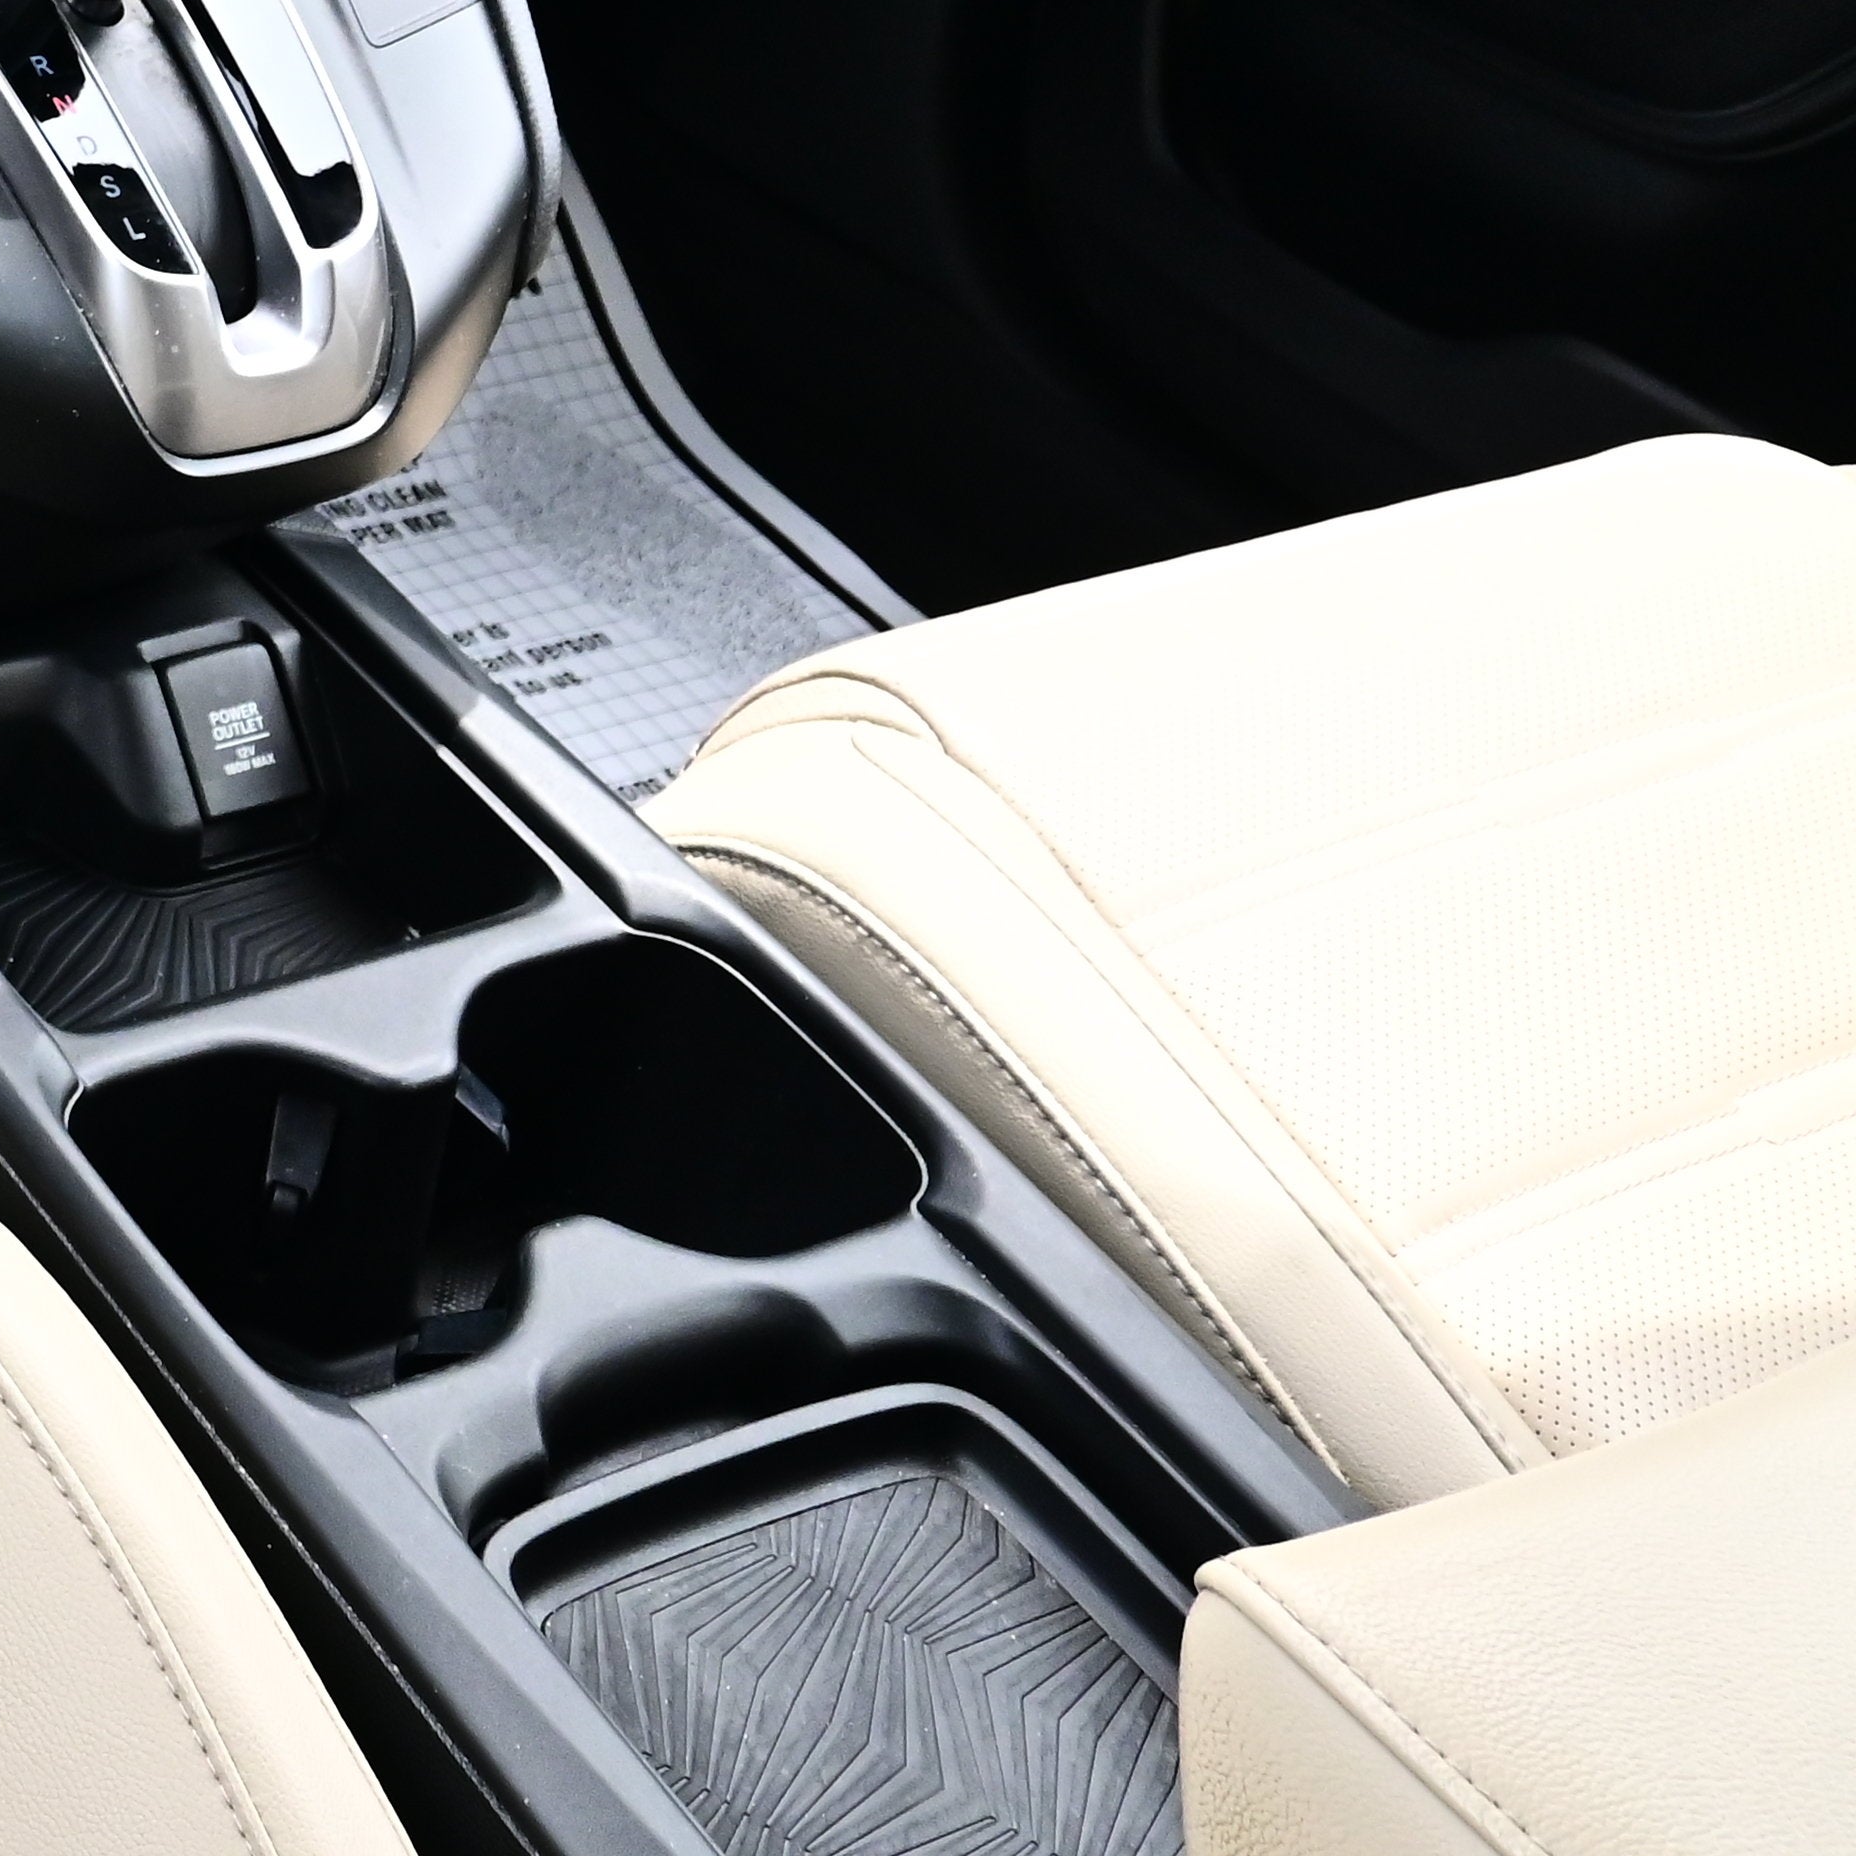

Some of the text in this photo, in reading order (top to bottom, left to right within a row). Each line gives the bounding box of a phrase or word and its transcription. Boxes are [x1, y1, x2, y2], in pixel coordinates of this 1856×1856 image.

[29, 55, 54, 77] R
[52, 94, 77, 115] N
[100, 175, 121, 198] S
[123, 216, 146, 241] L
[208, 701, 260, 726] POWER
[212, 715, 265, 742] OUTLET
